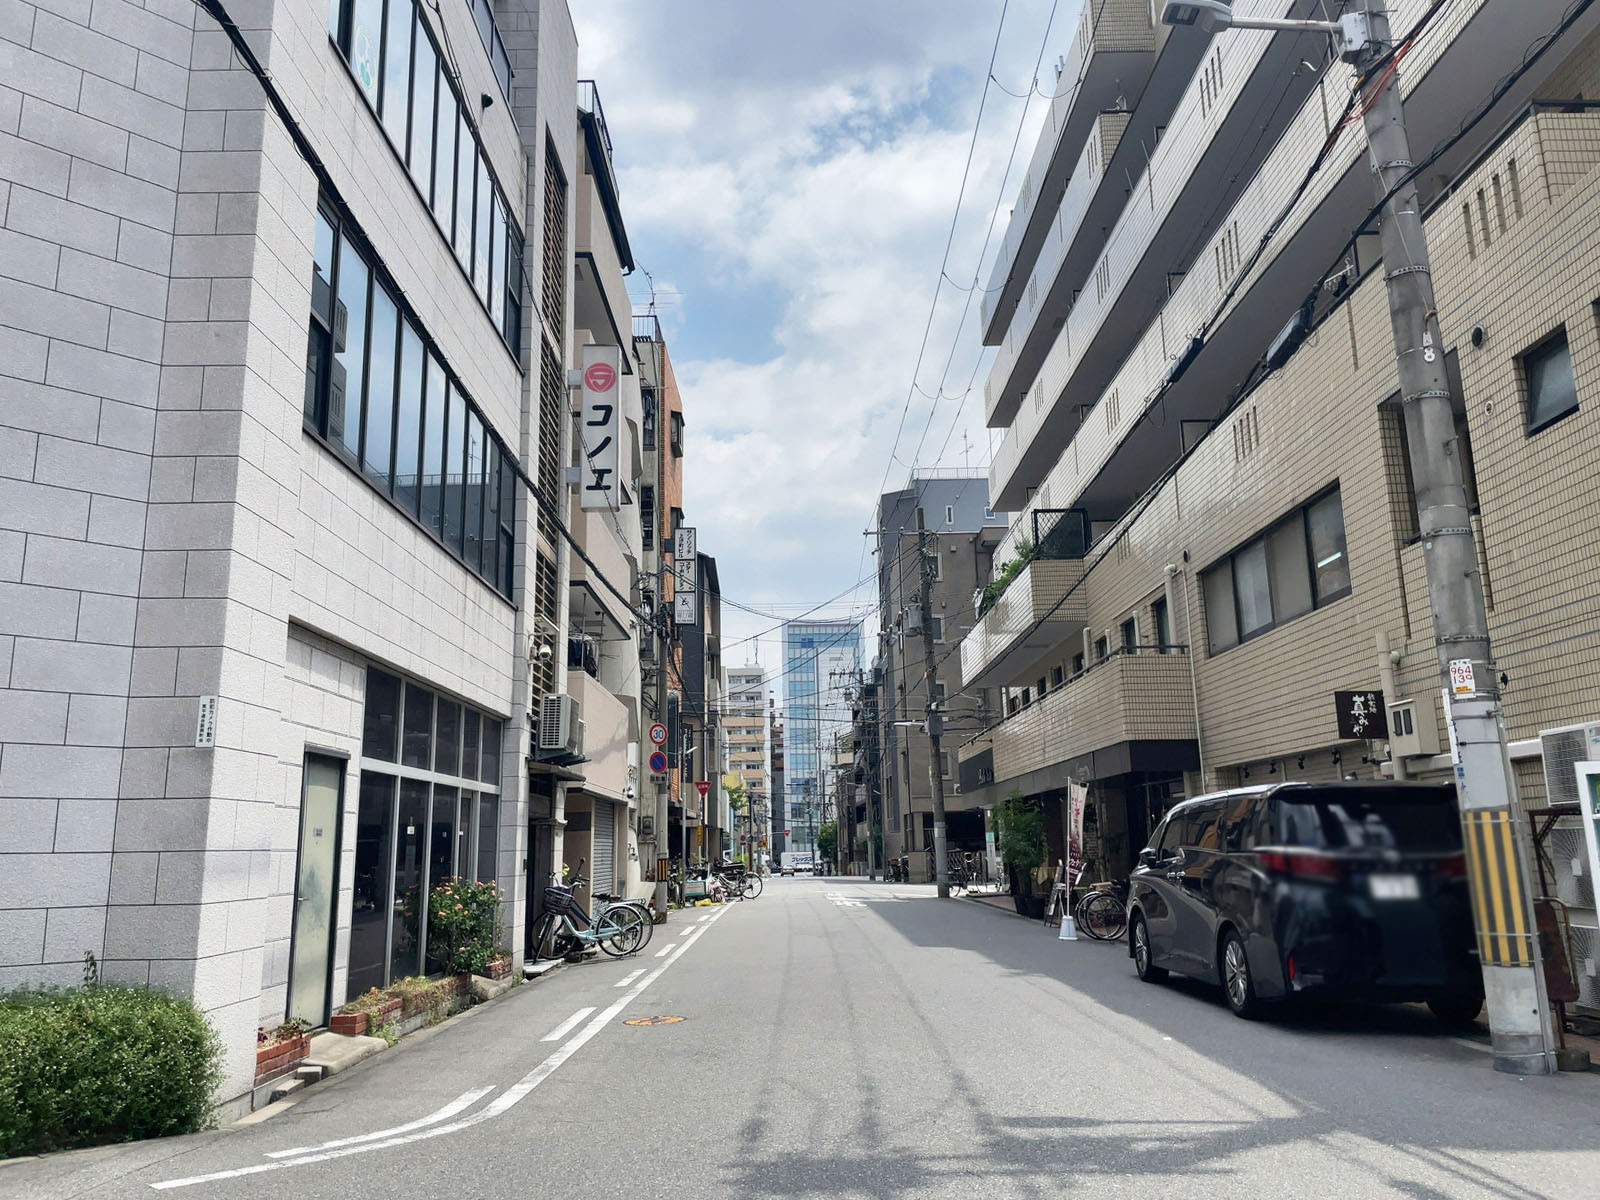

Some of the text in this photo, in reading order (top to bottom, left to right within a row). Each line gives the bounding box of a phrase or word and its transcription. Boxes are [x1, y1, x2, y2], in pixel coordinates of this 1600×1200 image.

[586, 404, 613, 491] コノエ
[1451, 665, 1471, 675] 964
[1453, 674, 1473, 684] 139
[653, 729, 664, 739] 30
